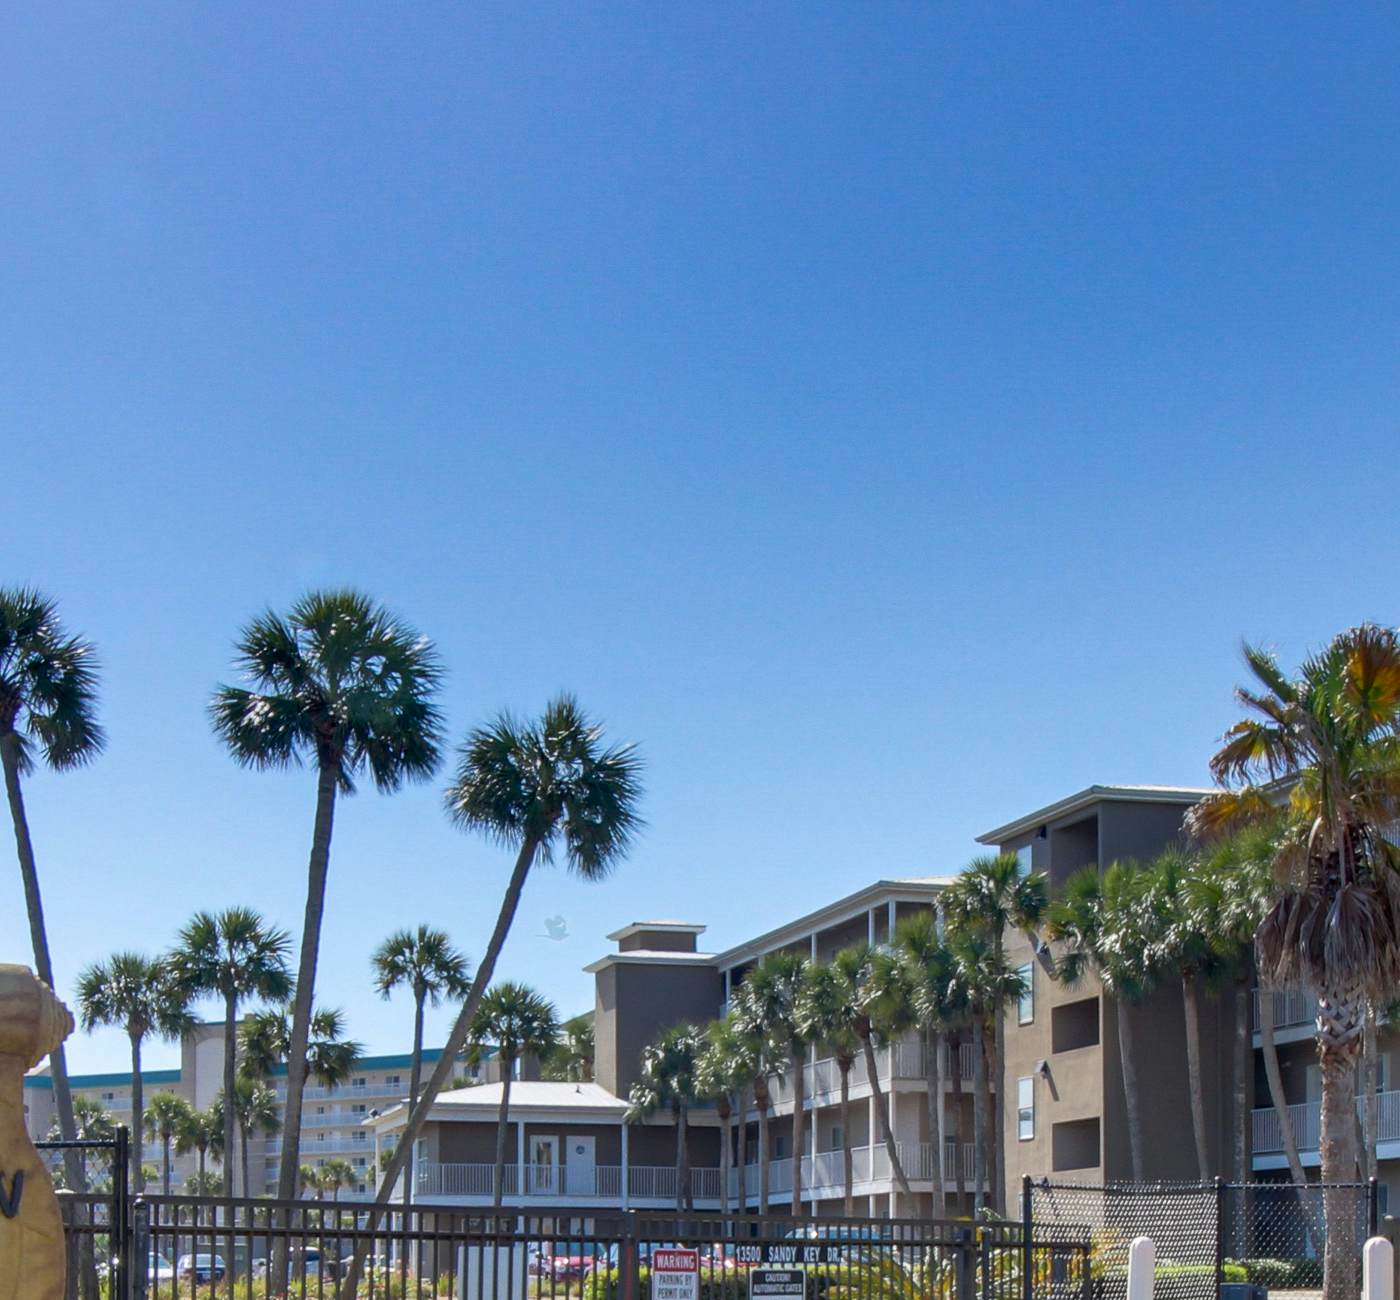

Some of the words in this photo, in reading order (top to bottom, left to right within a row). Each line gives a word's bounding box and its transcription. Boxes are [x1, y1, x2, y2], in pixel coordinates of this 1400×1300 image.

[736, 1246, 761, 1262] 13500
[768, 1246, 797, 1262] SANDY
[803, 1246, 821, 1262] KEY
[827, 1247, 840, 1262] DR.
[657, 1255, 695, 1269] WARNING
[659, 1274, 683, 1285] PARKING
[685, 1274, 693, 1286] BY
[658, 1287, 677, 1299] PERMIT
[679, 1287, 693, 1299] ONLY
